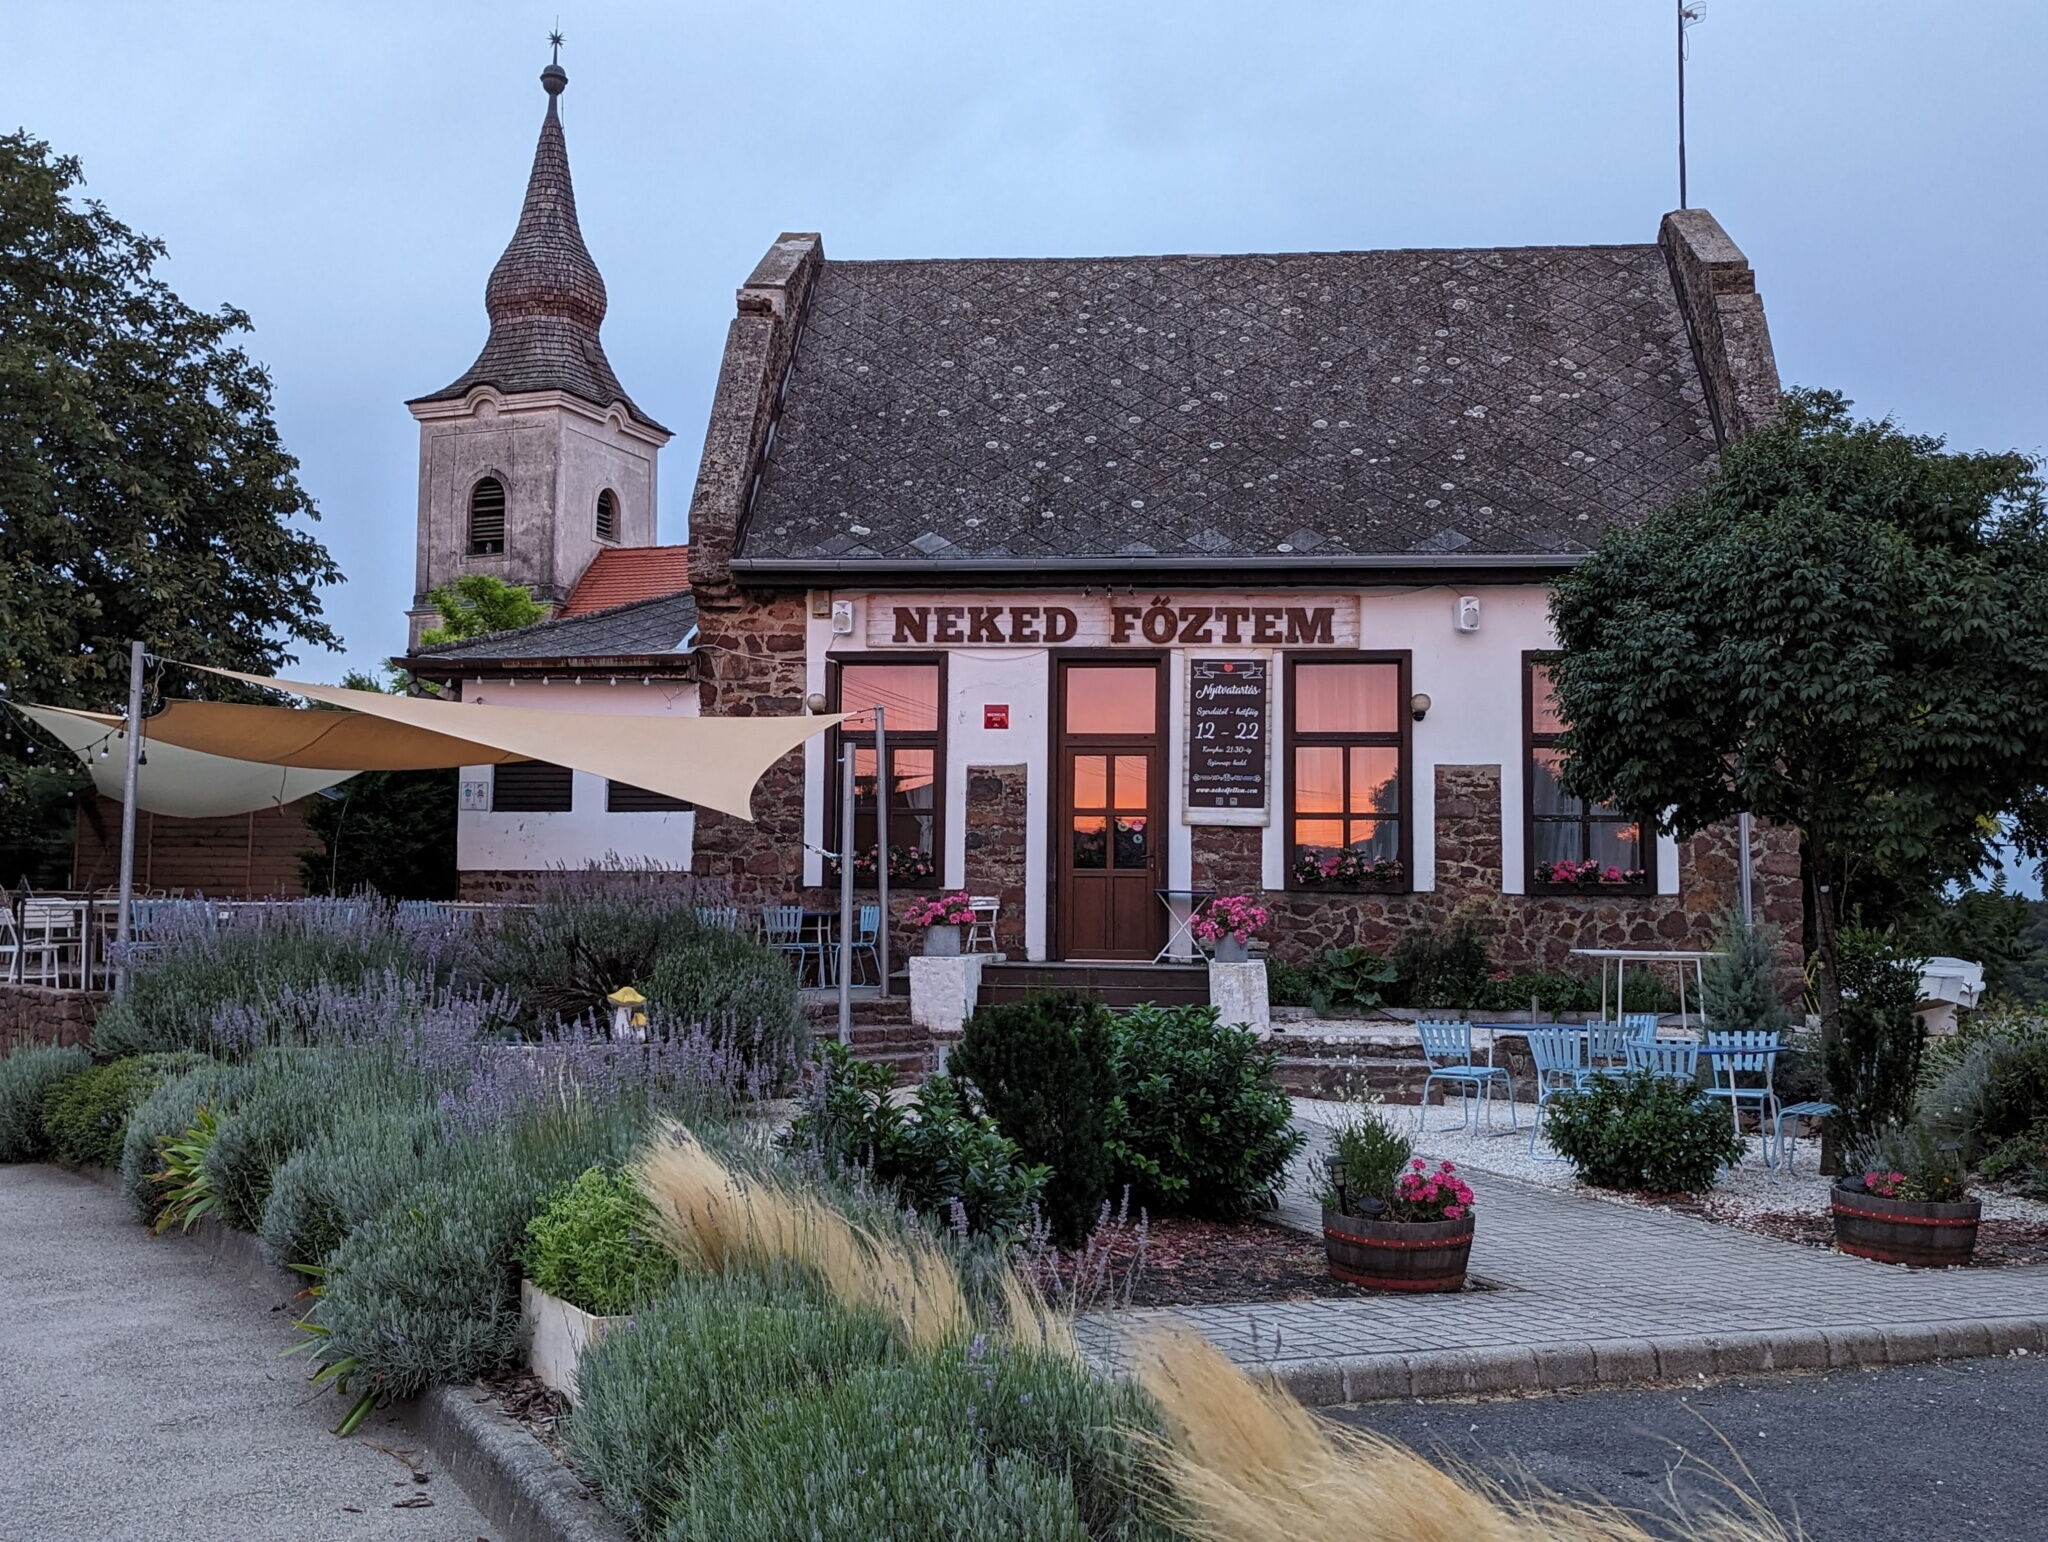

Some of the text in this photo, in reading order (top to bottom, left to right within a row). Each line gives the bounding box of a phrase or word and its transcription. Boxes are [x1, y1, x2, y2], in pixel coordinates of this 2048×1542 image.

[892, 595, 1335, 643] NEKED FŐZTEM
[1195, 722, 1215, 739] 12
[1234, 722, 1259, 739] 22
